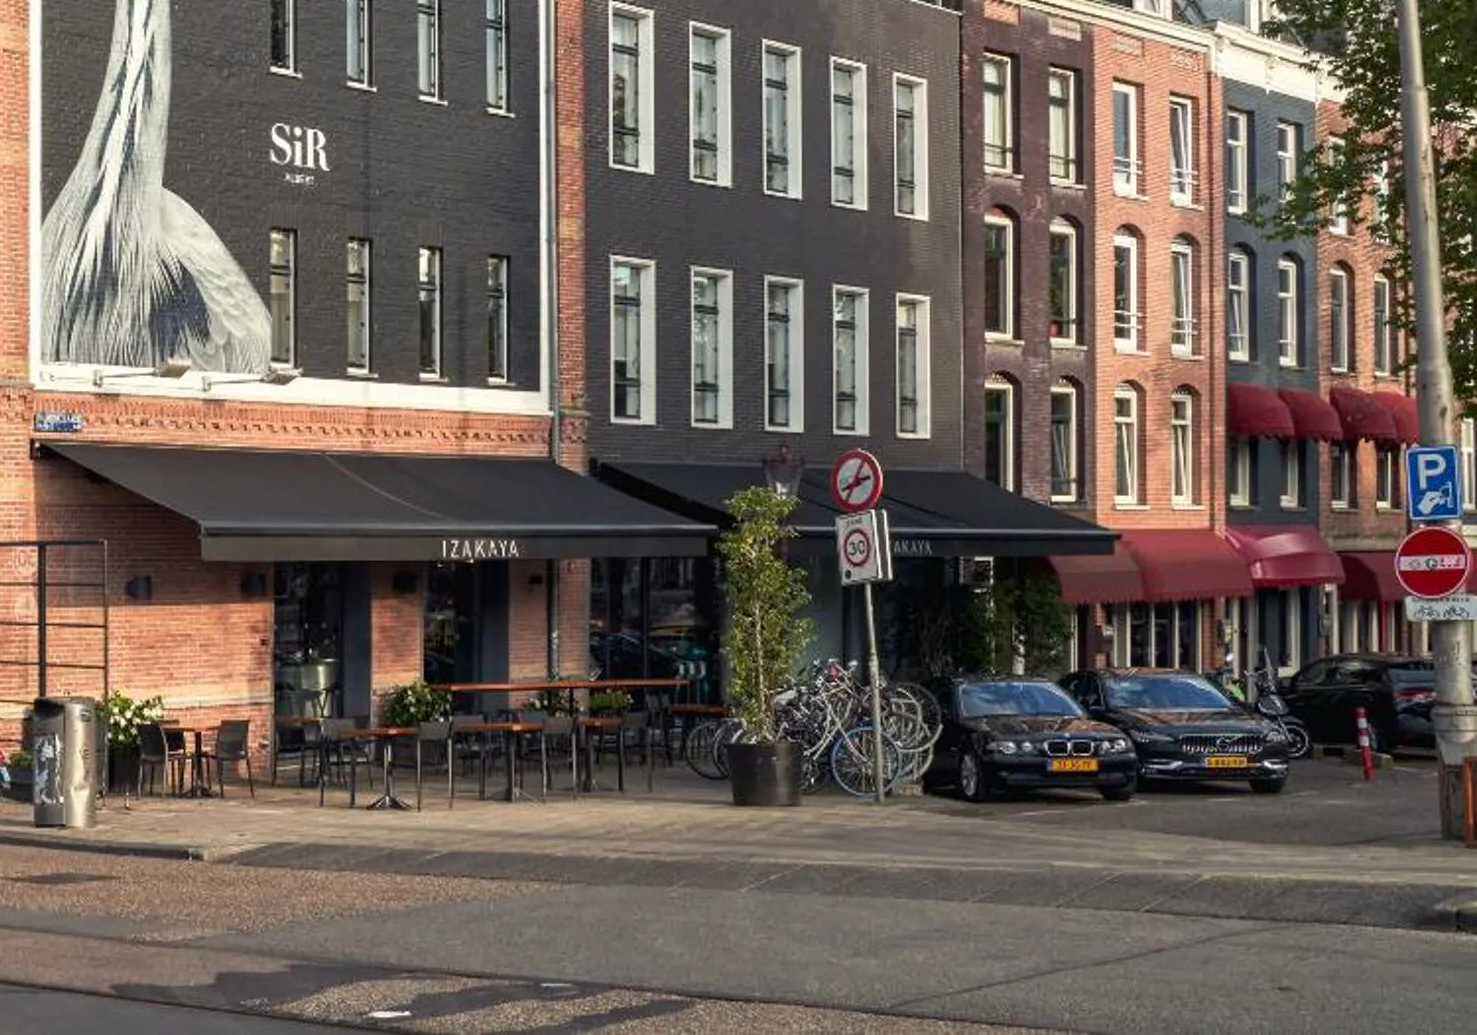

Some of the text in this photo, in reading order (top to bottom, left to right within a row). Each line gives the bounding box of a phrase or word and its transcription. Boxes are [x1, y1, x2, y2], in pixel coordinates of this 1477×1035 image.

[269, 122, 330, 172] SiR
[1417, 453, 1446, 490] P
[442, 539, 520, 558] IZAKAYA
[848, 540, 866, 556] 30
[893, 539, 933, 556] AKAYA
